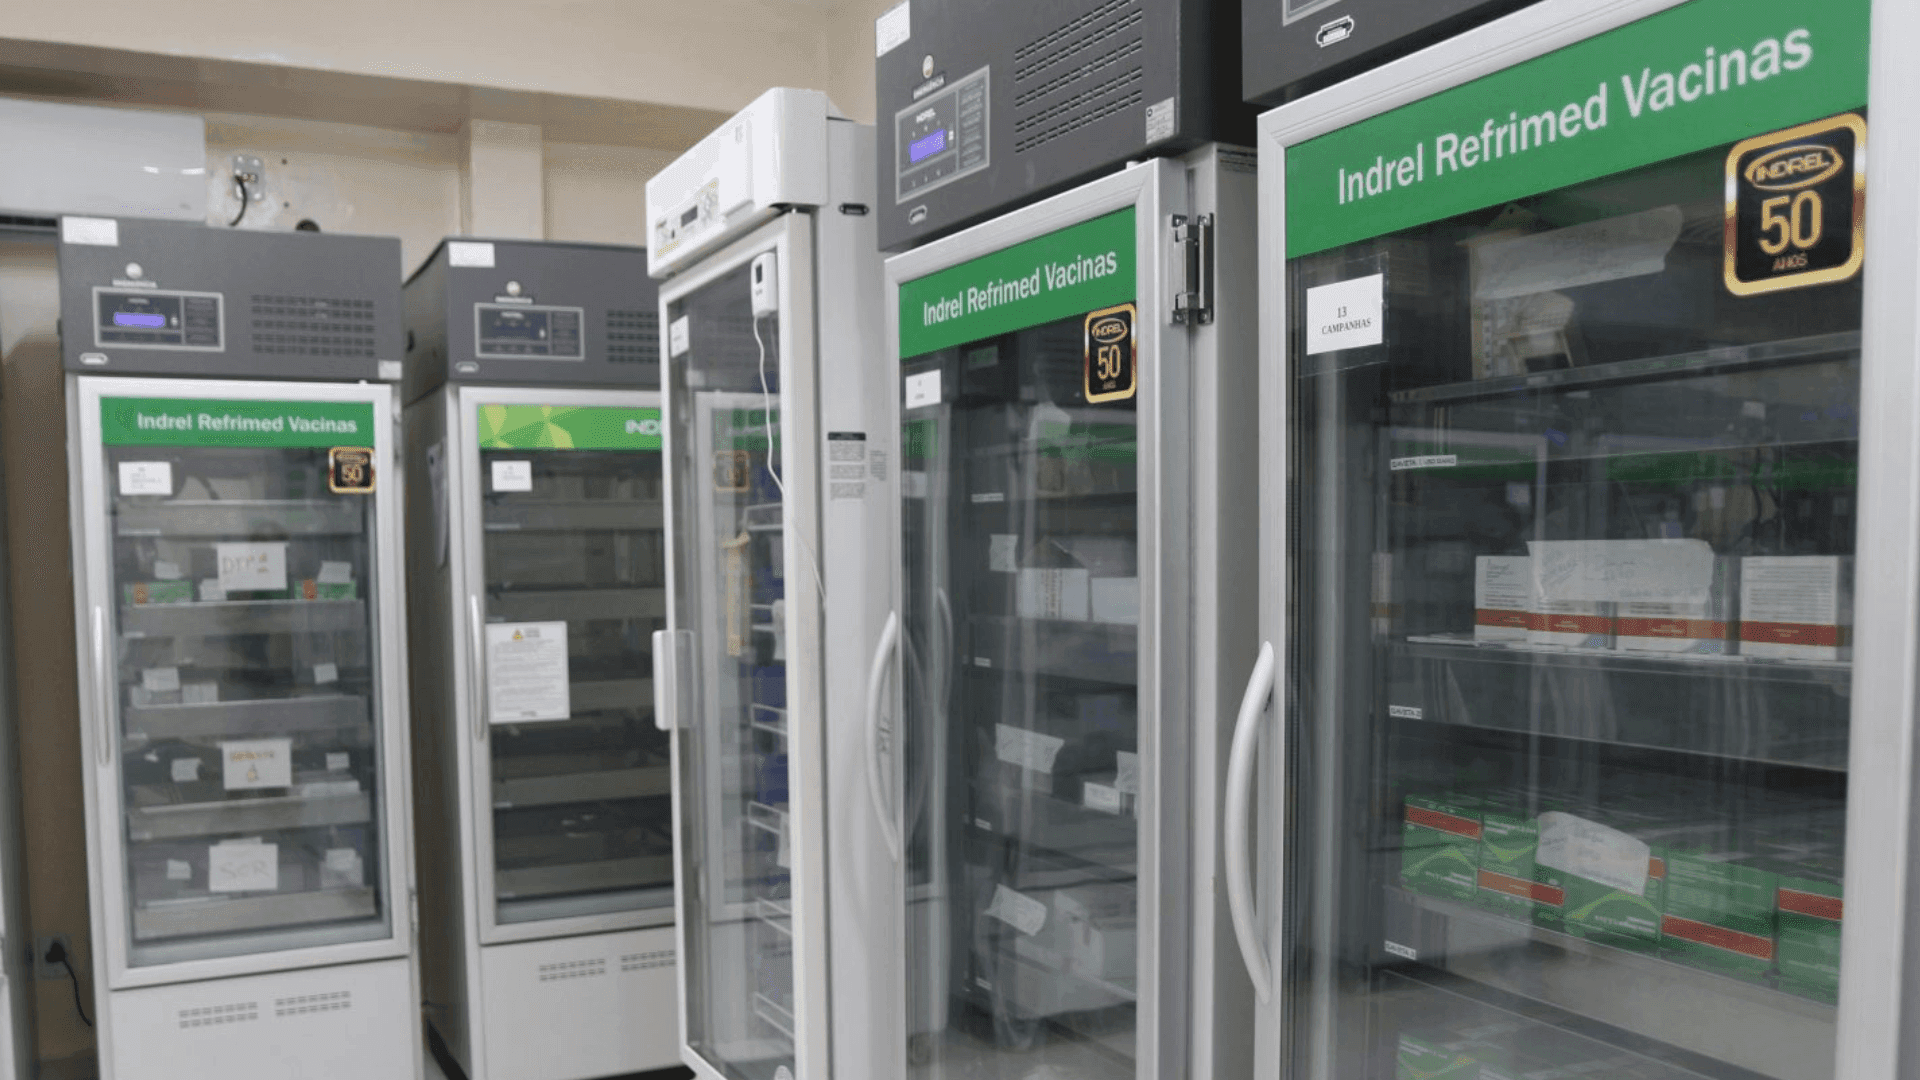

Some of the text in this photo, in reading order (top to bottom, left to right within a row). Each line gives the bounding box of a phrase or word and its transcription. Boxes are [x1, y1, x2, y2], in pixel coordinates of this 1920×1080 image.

[1338, 27, 1813, 205] Indrel Refrimed Vacinas
[1756, 152, 1830, 181] INDREL
[1758, 190, 1823, 255] 50
[1772, 253, 1808, 271] ANOS
[923, 251, 1117, 326] Indrel Refrimed Vacinas
[1321, 318, 1372, 334] CAMPANHAS
[1337, 306, 1347, 318] 13
[1097, 345, 1121, 380] 50
[137, 412, 358, 433] Indrel Refrimed Vacinas
